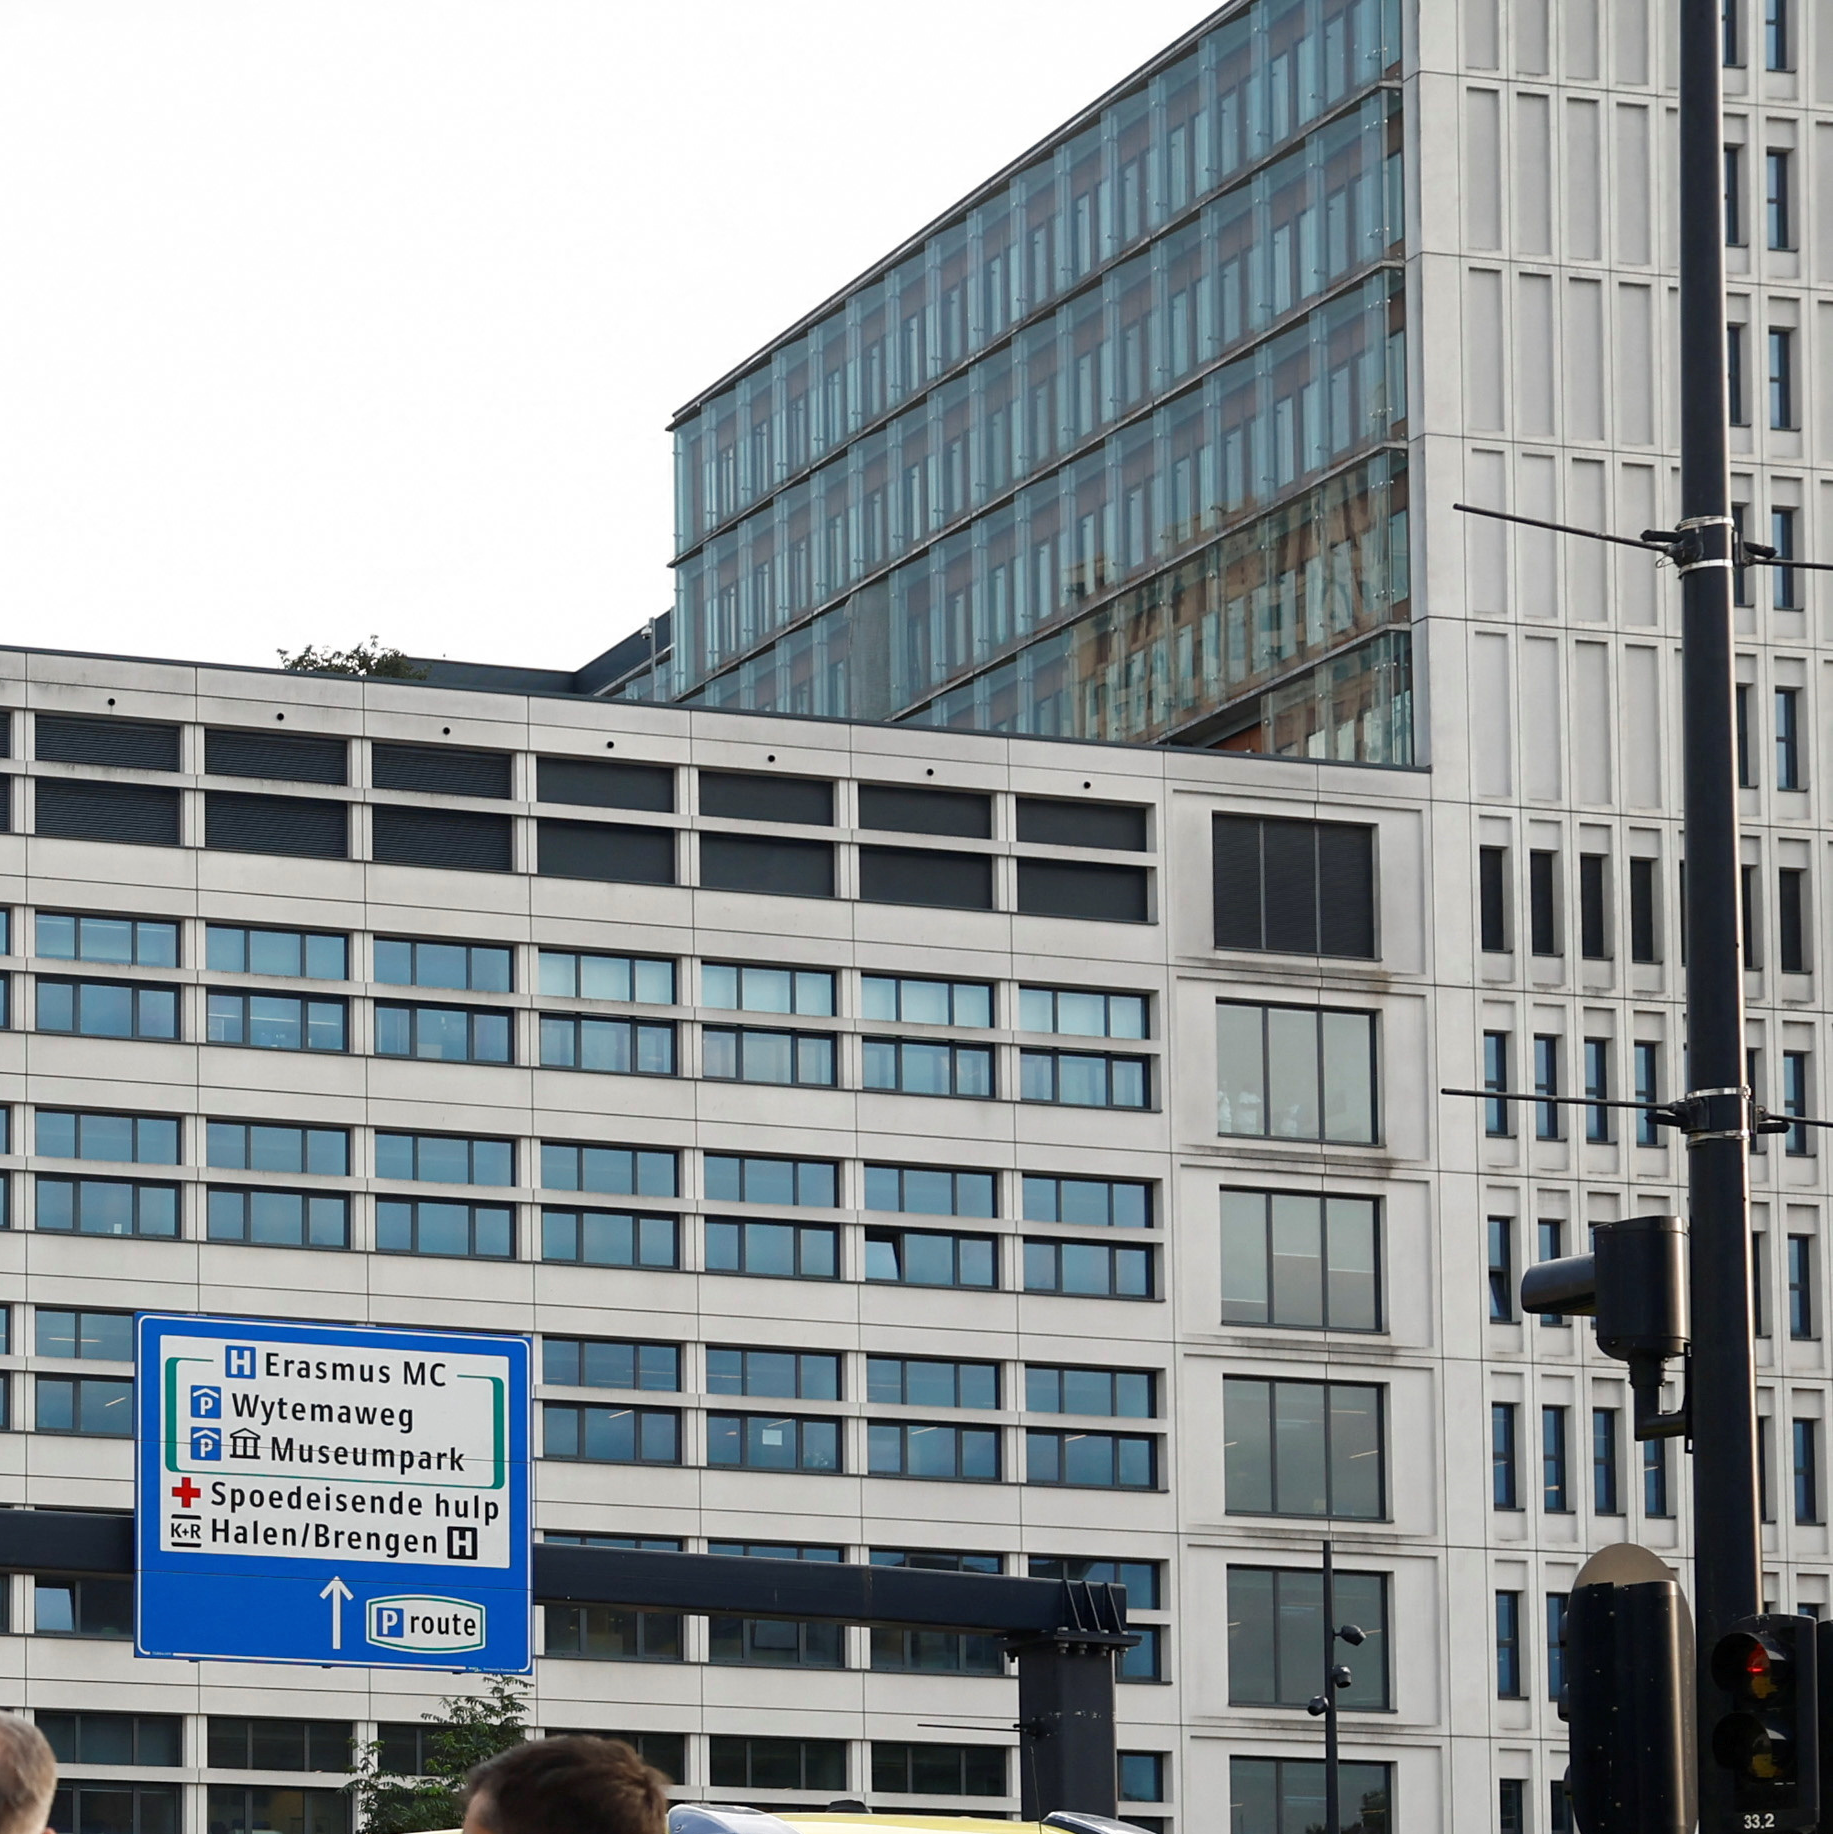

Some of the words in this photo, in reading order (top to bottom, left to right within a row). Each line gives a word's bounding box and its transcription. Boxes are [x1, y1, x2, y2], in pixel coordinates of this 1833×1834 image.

[265, 1353, 391, 1384] Erasmus
[403, 1361, 447, 1387] MC
[232, 1392, 414, 1433] Wytemaweg
[271, 1436, 465, 1475] Museumpark
[210, 1481, 423, 1517] Spoedeisende
[435, 1493, 500, 1525] hulp
[170, 1522, 201, 1540] K+R
[211, 1518, 437, 1558] Halen/Brengen
[410, 1609, 476, 1637] route
[1744, 1813, 1775, 1829] 33.2
